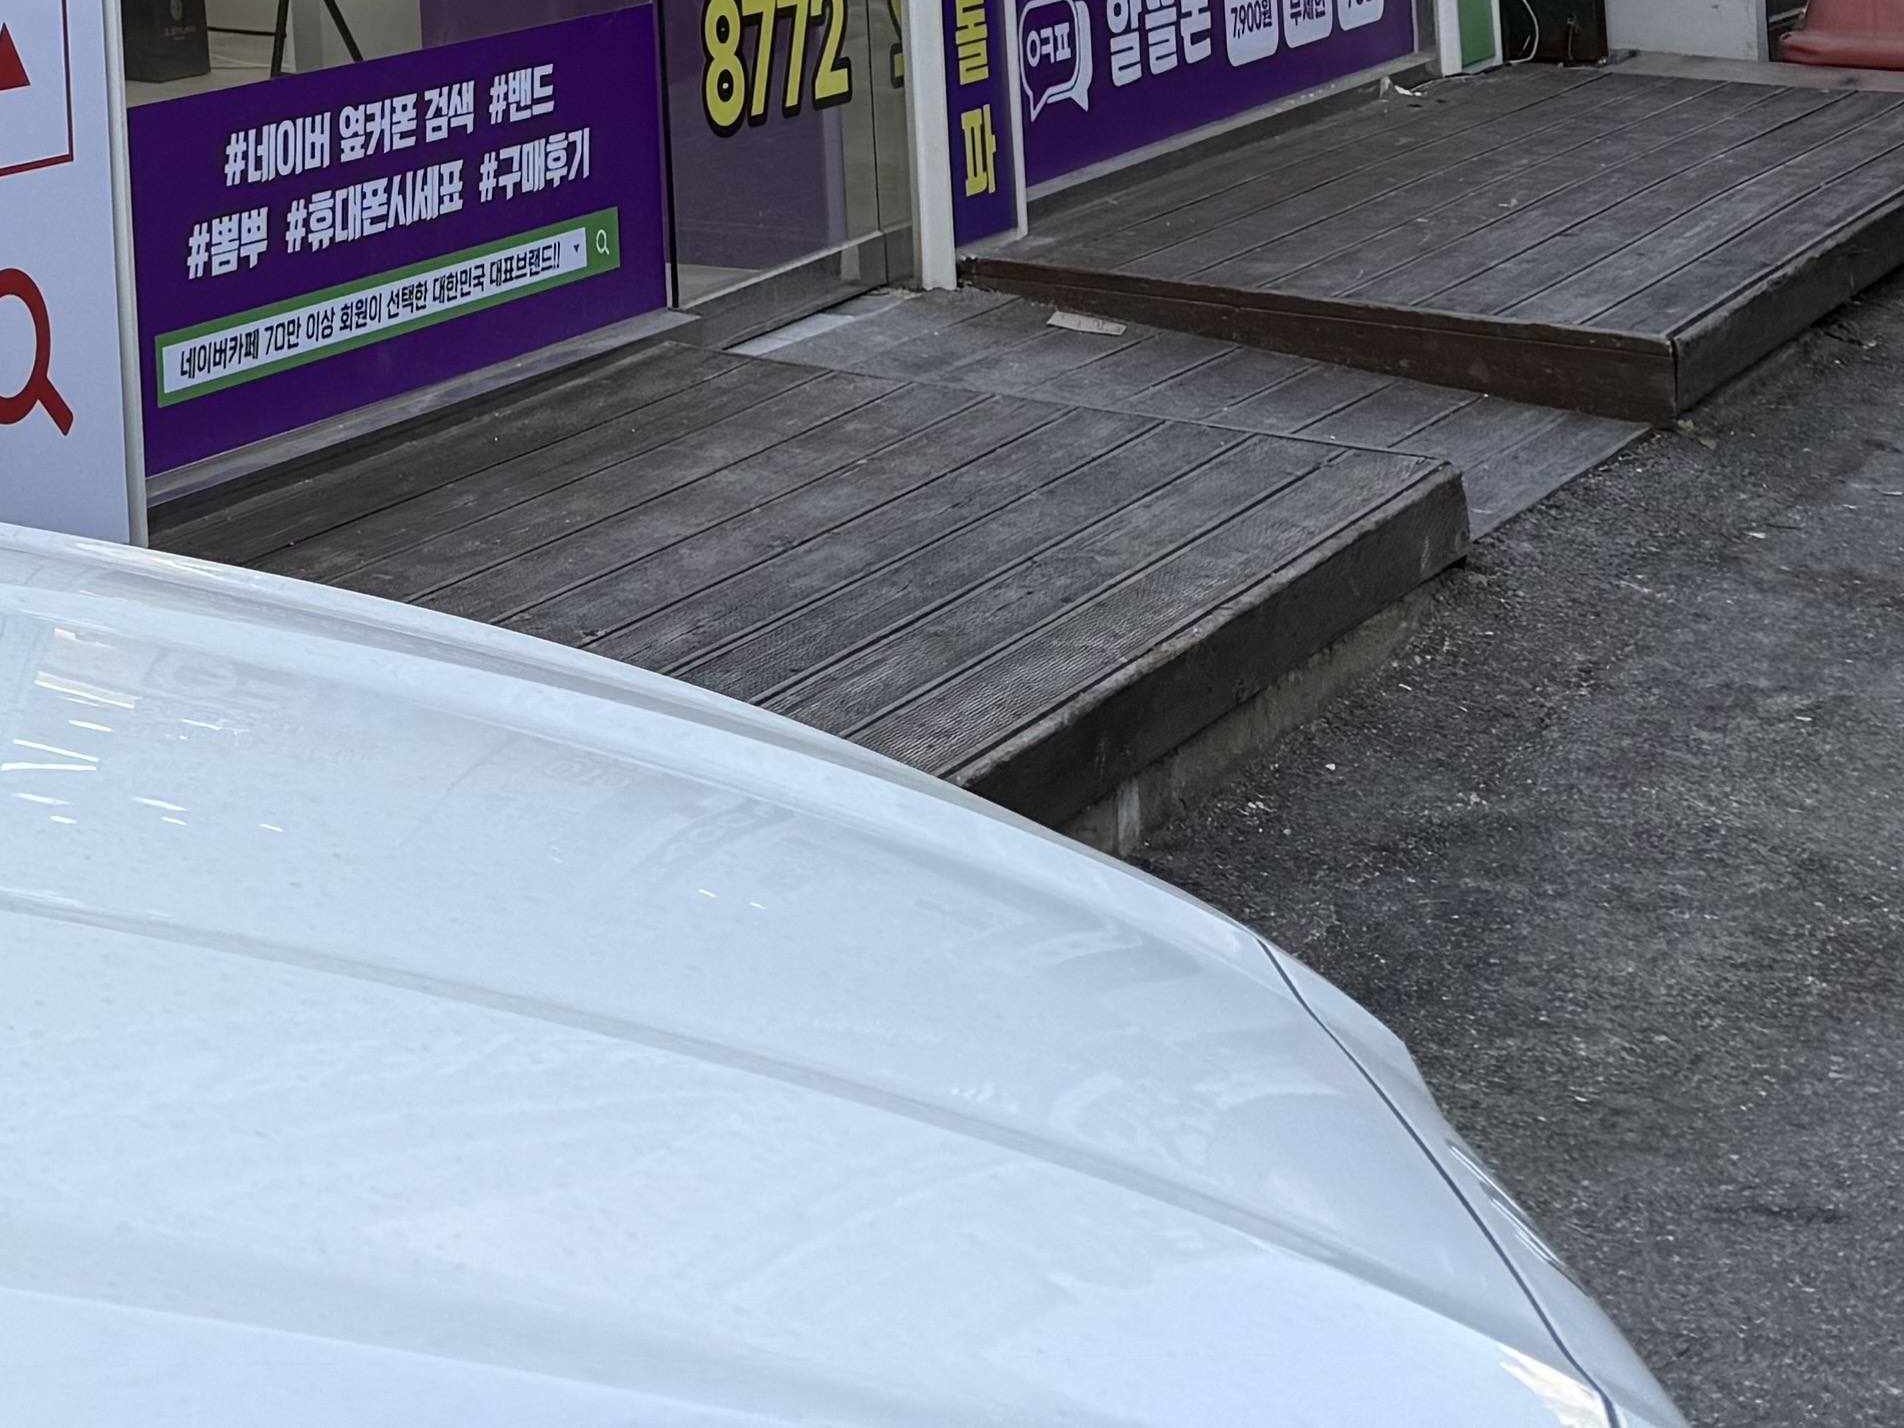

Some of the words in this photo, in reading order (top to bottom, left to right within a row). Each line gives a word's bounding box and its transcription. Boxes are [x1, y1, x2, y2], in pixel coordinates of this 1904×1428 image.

[225, 111, 332, 187] #네이버
[339, 92, 418, 163] 옆커폰
[425, 80, 475, 143] 검색
[489, 63, 554, 125] #밴드
[187, 206, 268, 279] #뽐뿌
[285, 159, 464, 254] #휴대폰시세표
[479, 127, 591, 202] #구매후기
[180, 327, 259, 378] 네이버카페
[264, 318, 301, 354] 70만
[306, 308, 336, 342] 이상
[339, 293, 382, 332] 회원이
[386, 280, 427, 320] 선택한
[433, 265, 485, 304] 대한민국
